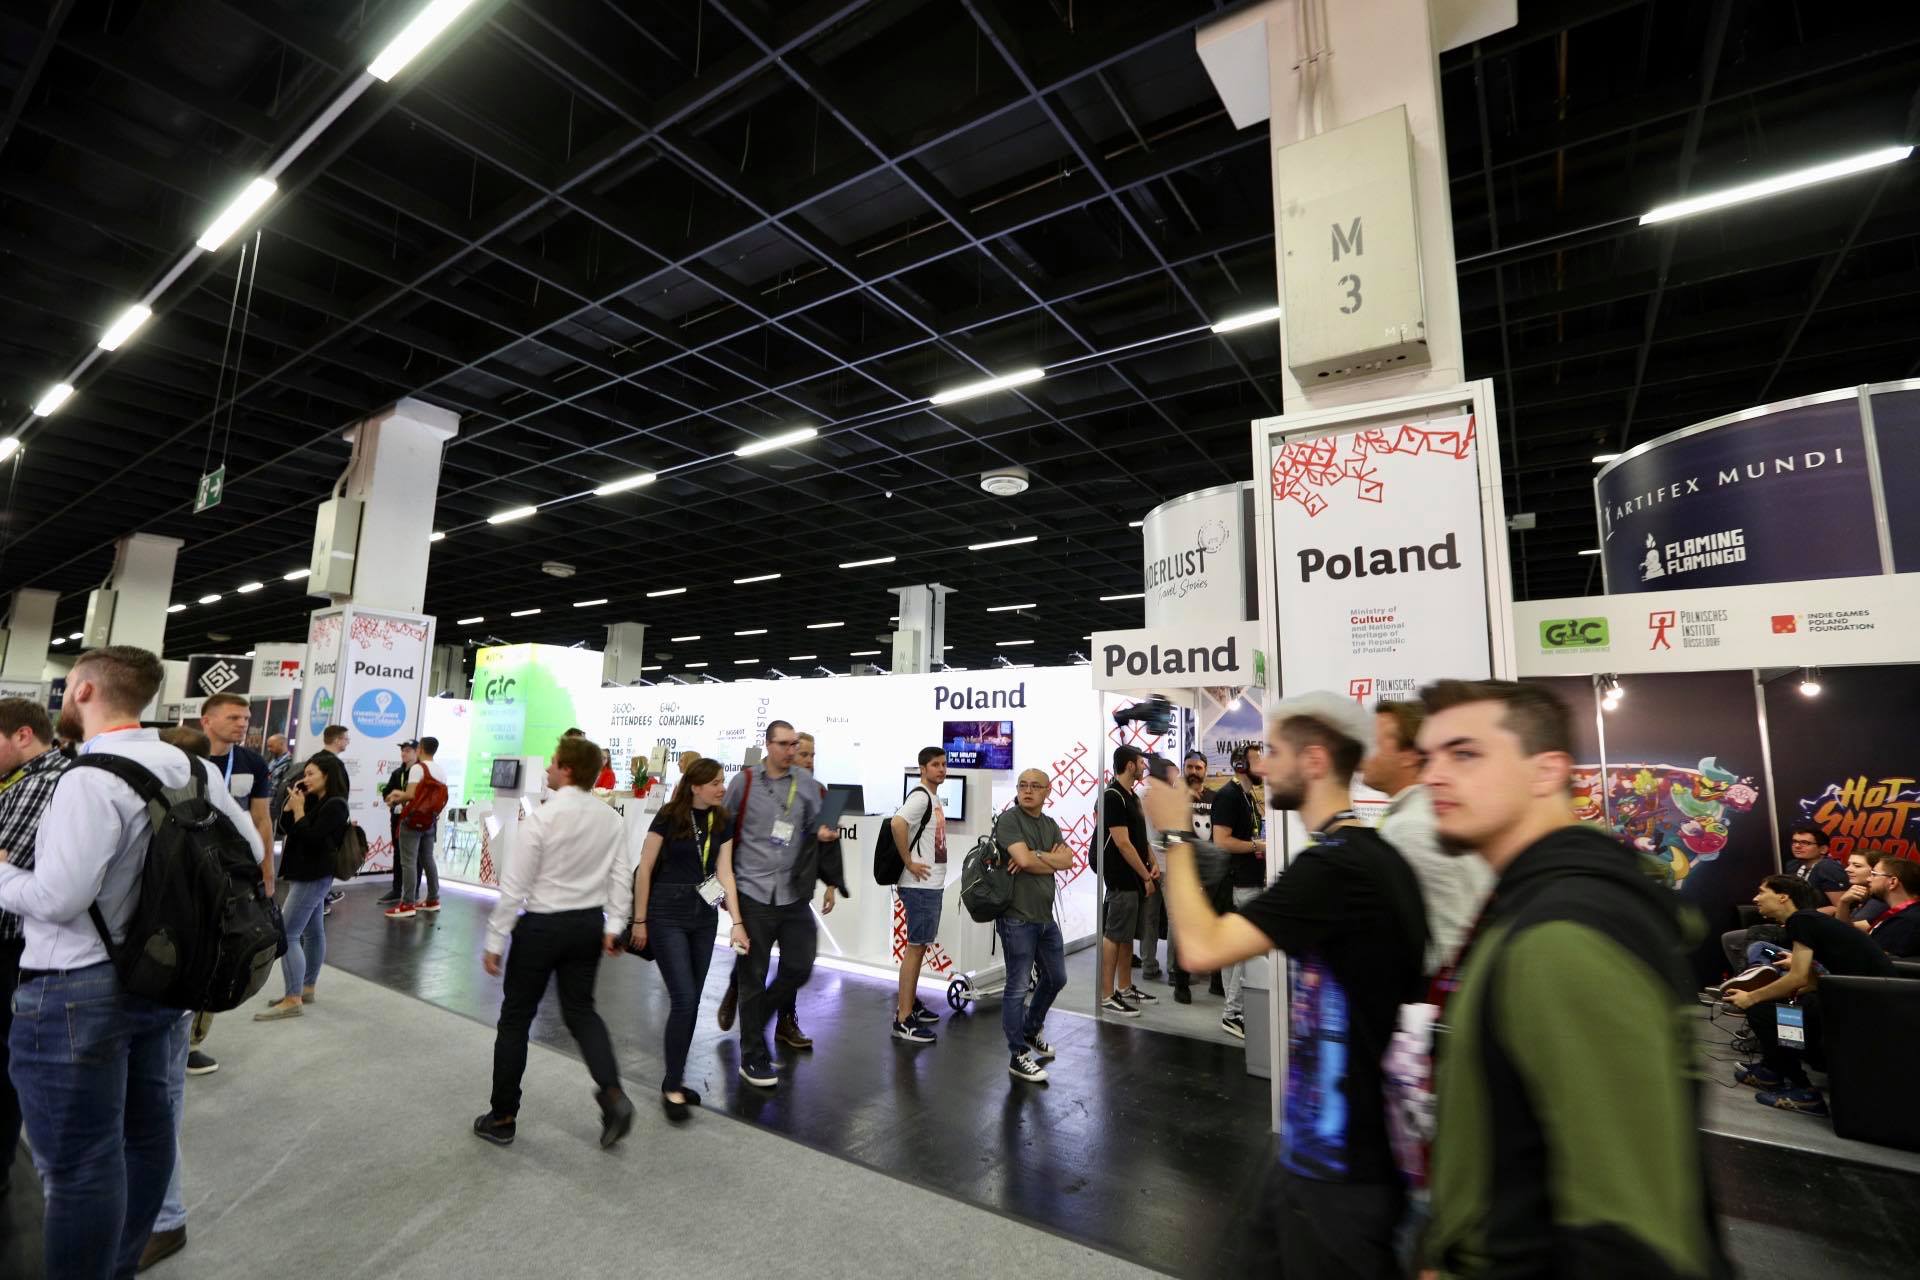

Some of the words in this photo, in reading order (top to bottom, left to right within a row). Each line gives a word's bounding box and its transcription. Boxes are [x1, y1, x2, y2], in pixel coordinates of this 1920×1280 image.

[1331, 216, 1364, 262] M
[1337, 274, 1363, 314] 3
[1616, 477, 1700, 520] ARTIFEX
[1718, 448, 1844, 486] MUNDI
[1665, 528, 1745, 560] FLAMING
[1297, 532, 1461, 583] Poland
[1667, 546, 1746, 575] FLAMINGO
[1350, 608, 1385, 616] Ministry
[1388, 605, 1397, 613] of
[1680, 609, 1728, 623] POLNISCHES
[1807, 611, 1833, 619] INDIE
[1836, 609, 1870, 618] GAMES
[1350, 615, 1394, 624] Culture
[1808, 618, 1848, 626] POLAND
[1351, 625, 1366, 633] and
[1369, 622, 1405, 631] National
[1681, 624, 1716, 637] INSTITUT
[1809, 623, 1875, 632] FOUNDATION
[1103, 636, 1239, 677] Poland
[354, 660, 414, 680] Poland
[1376, 678, 1416, 692] POLNISCHES
[934, 682, 1026, 710] Poland
[611, 715, 652, 726] ATTENDEES
[659, 714, 705, 726] COMPANIES
[1814, 799, 1920, 839] SHOT
